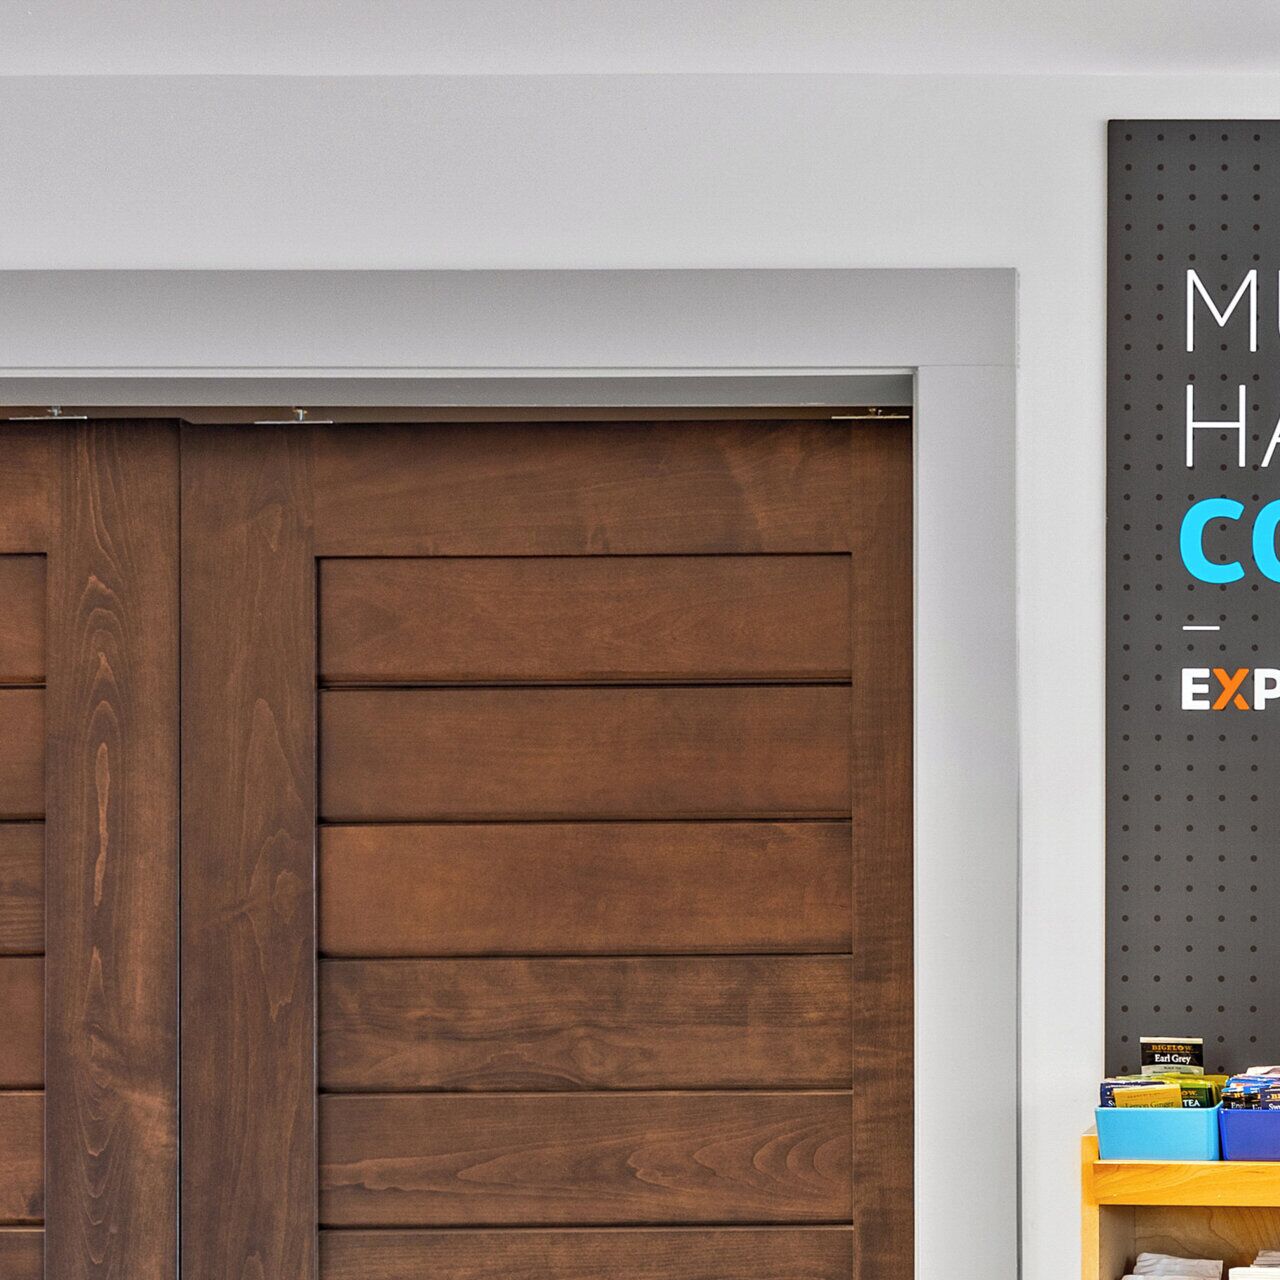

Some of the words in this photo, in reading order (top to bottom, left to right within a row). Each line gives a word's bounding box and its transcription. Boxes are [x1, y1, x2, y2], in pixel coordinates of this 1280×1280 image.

[1154, 1053, 1170, 1062] Earl
[1171, 1054, 1191, 1064] Grey
[1182, 1099, 1201, 1107] TEA
